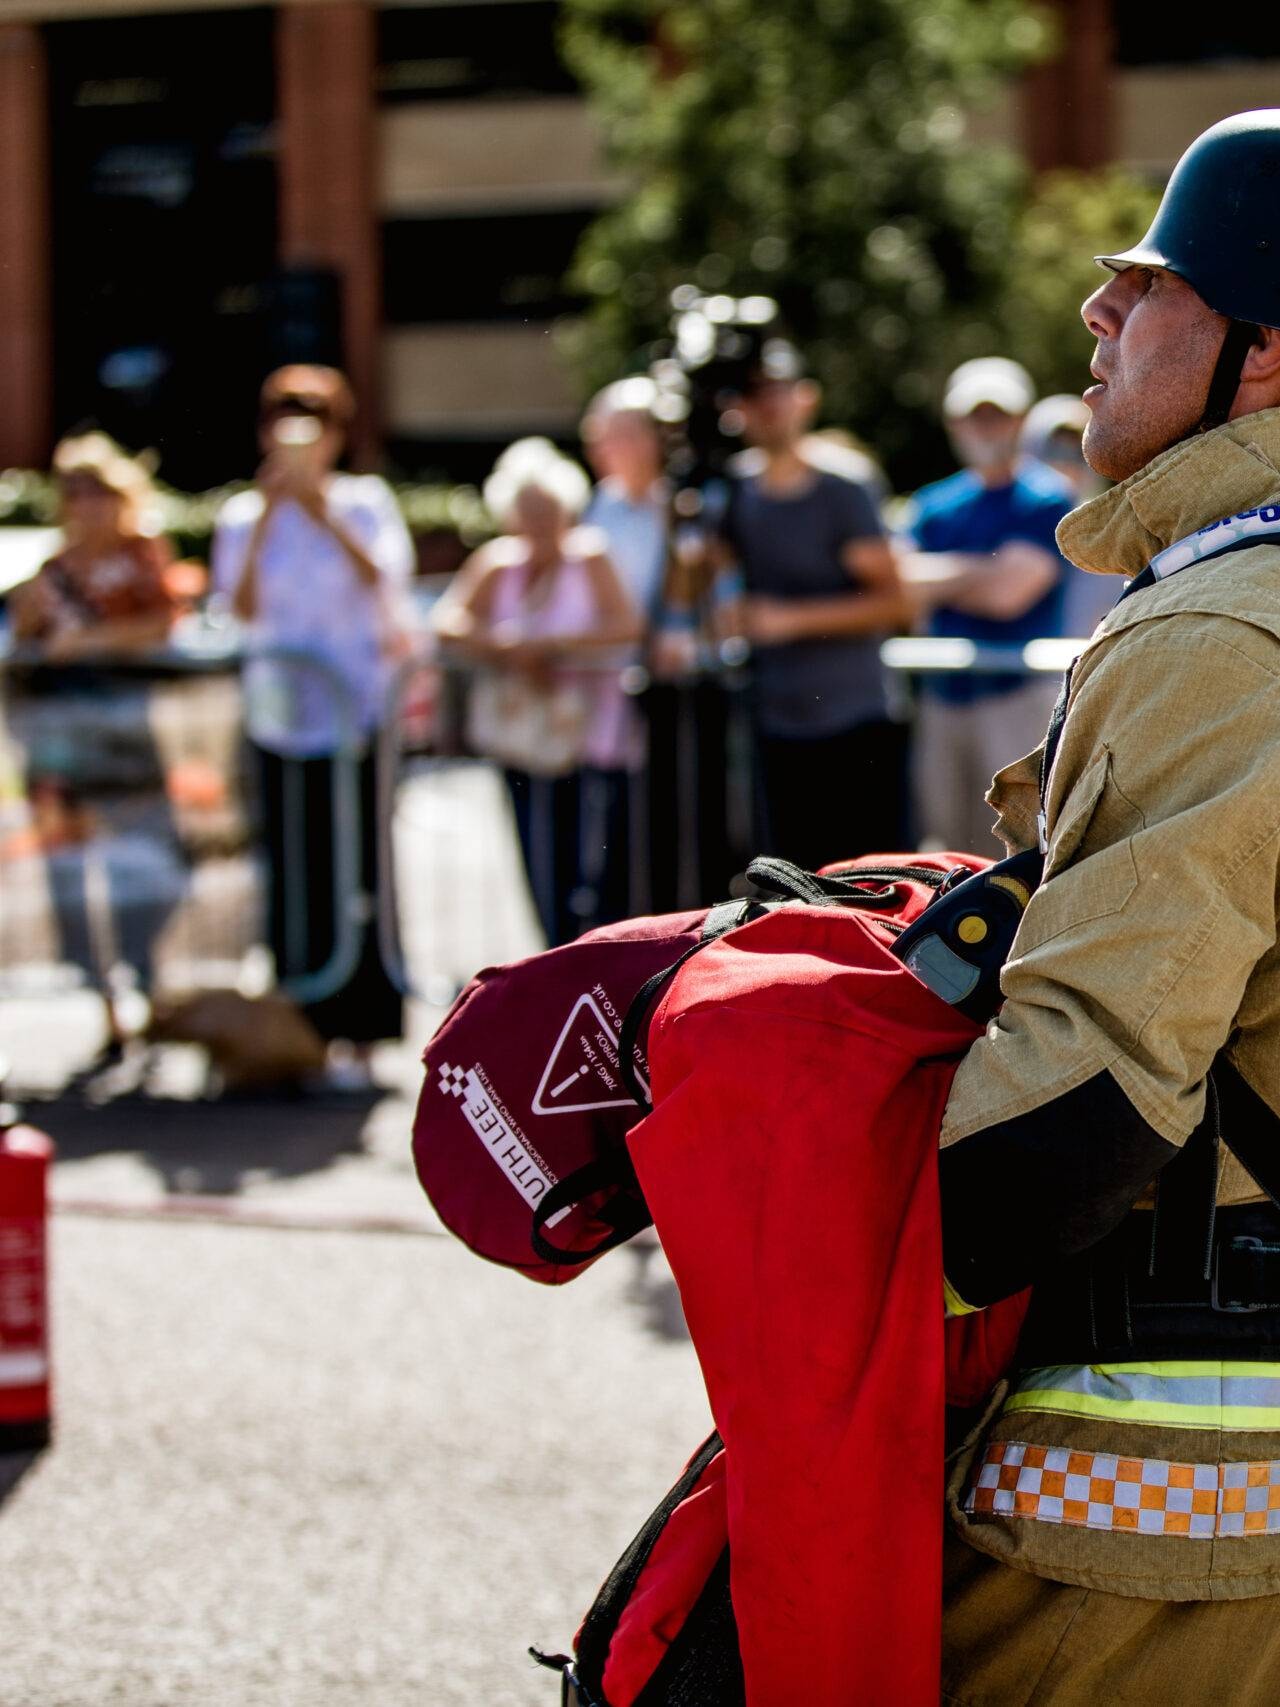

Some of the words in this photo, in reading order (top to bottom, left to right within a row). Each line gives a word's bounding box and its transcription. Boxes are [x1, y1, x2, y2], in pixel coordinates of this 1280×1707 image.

[594, 1031, 620, 1068] APPROX
[474, 1062, 490, 1085] LIVES
[597, 1067, 617, 1091] 70KG
[485, 1084, 501, 1106] SAVE
[470, 1098, 507, 1145] LEE
[500, 1105, 517, 1128] WHO
[515, 1127, 560, 1185] OFESSIONALS
[501, 1145, 546, 1199] UTH
